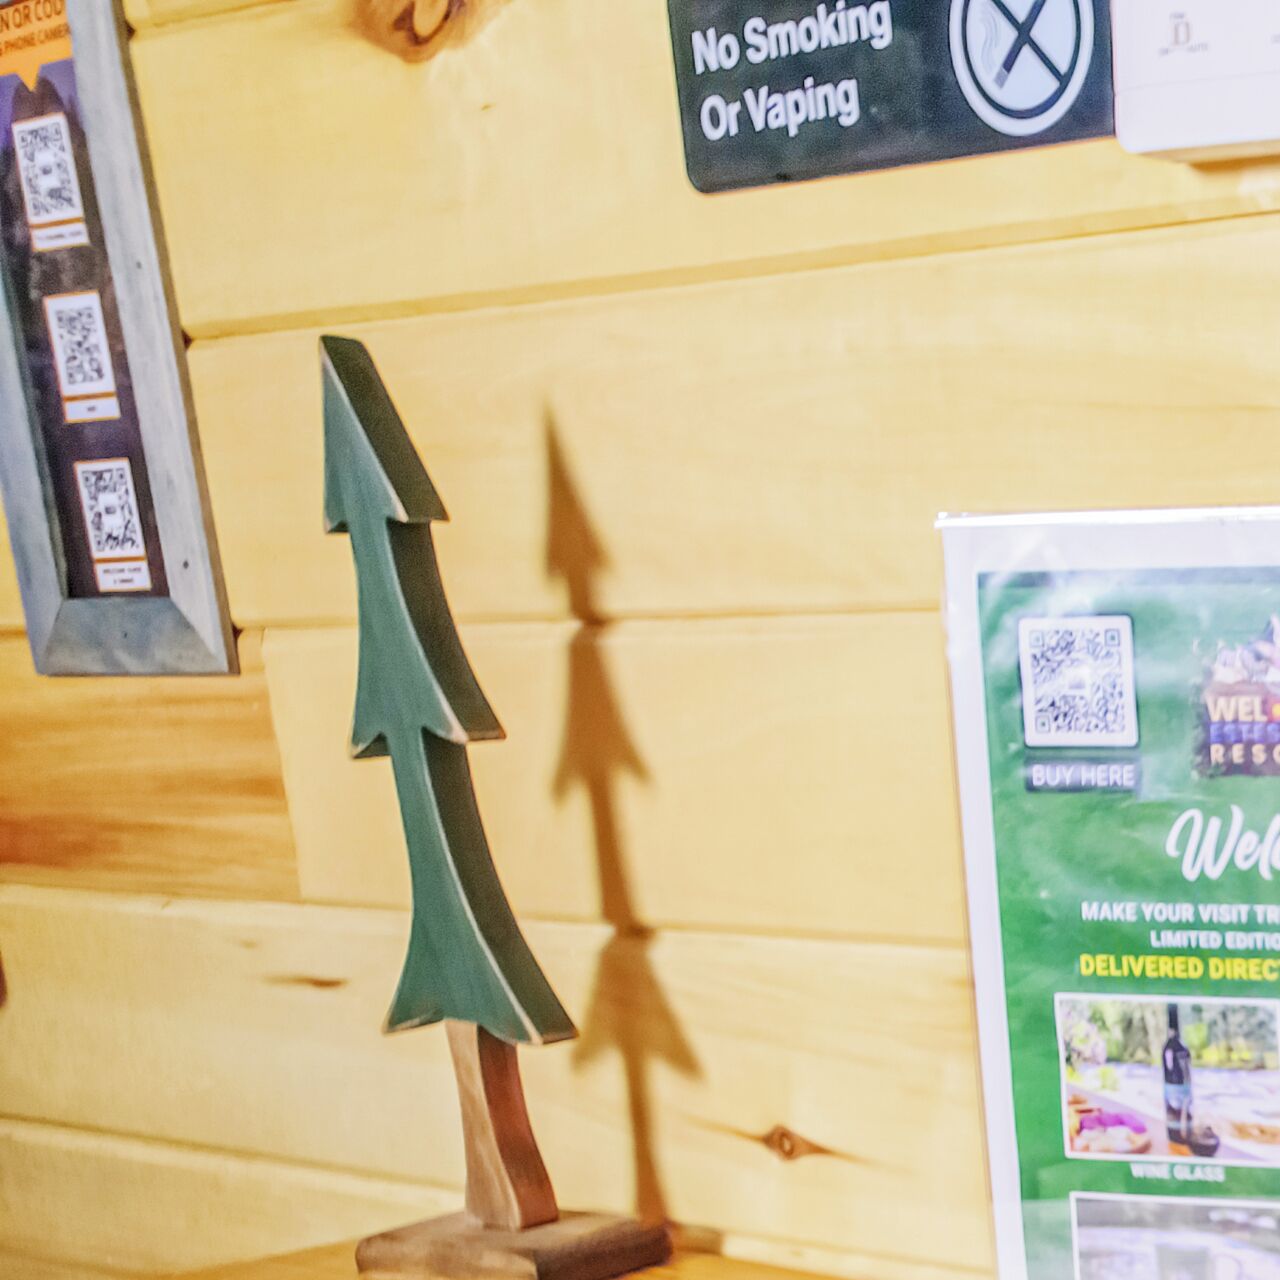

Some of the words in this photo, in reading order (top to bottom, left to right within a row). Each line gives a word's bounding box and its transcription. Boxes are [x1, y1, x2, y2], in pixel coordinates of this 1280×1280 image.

[691, 26, 740, 75] No
[743, 0, 893, 64] Smoking
[700, 94, 741, 141] Or
[742, 75, 860, 138] Vaping
[1032, 764, 1074, 786] BUY
[1081, 764, 1135, 787] HERE
[1081, 901, 1138, 922] MAKE
[1142, 903, 1194, 923] YOUR
[1199, 904, 1250, 924] VISIT
[1150, 929, 1222, 949] LIMITED
[1080, 954, 1204, 979] DELIVERED
[1130, 1163, 1169, 1179] WINE
[1173, 1164, 1225, 1182] GLASS
